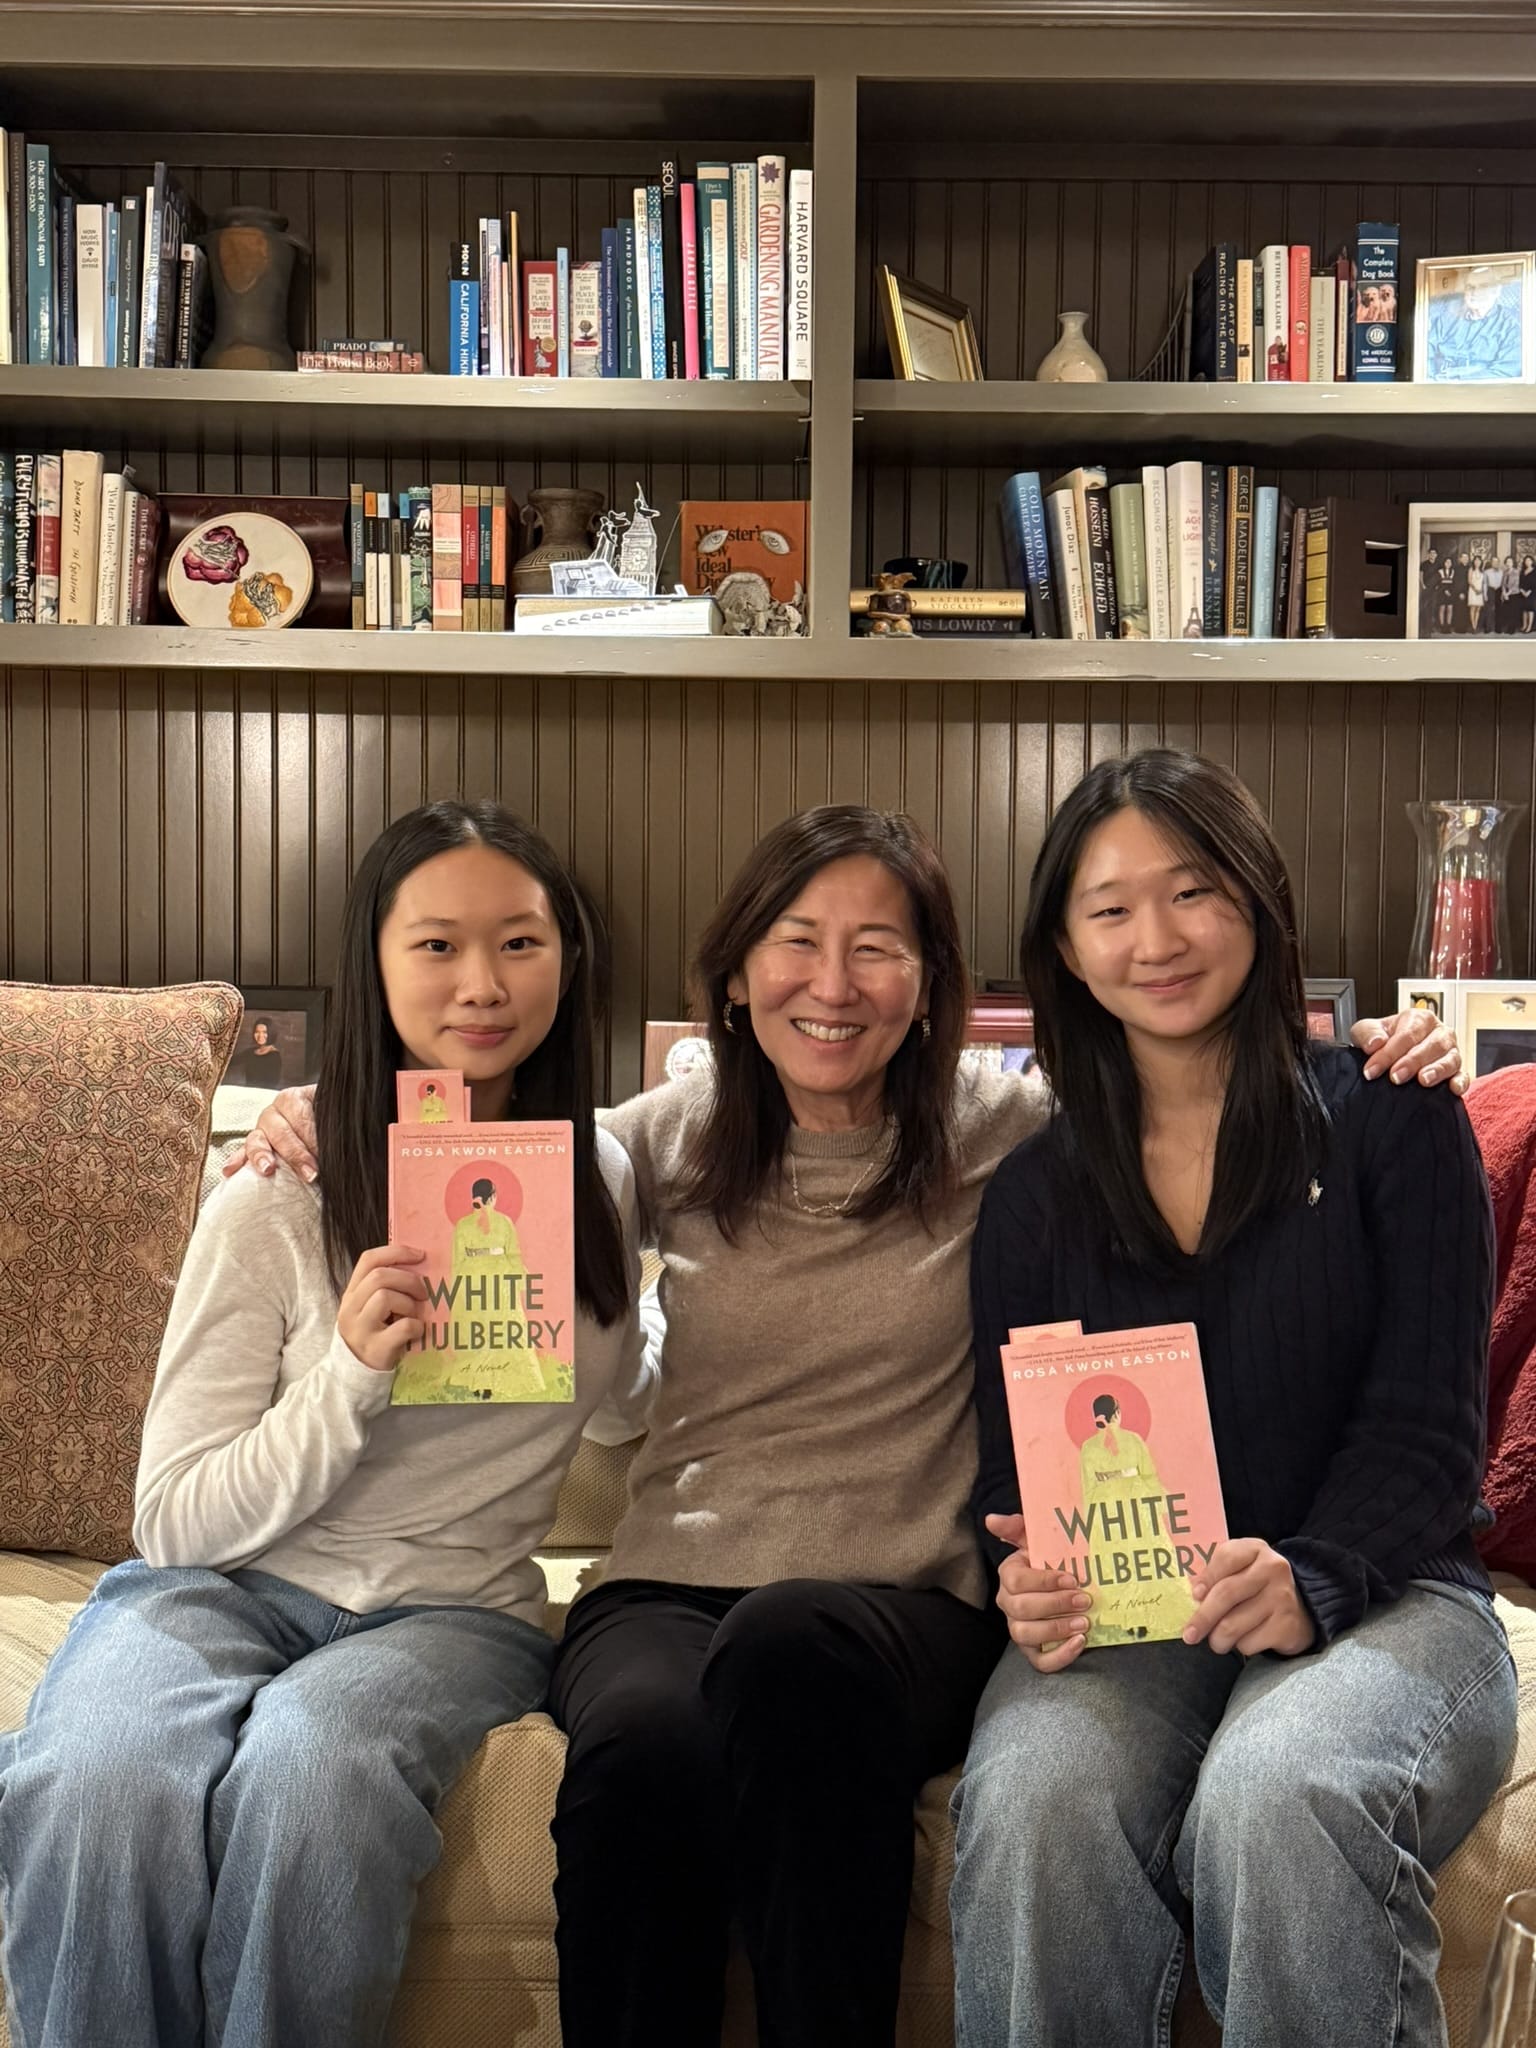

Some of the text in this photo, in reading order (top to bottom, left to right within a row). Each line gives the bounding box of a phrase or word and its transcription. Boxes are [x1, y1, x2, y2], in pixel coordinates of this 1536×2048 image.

[662, 161, 674, 198] SEOUL
[36, 160, 46, 267] the art of medieval spain
[714, 202, 726, 281] CHAPMAN
[740, 241, 748, 261] GOLF
[759, 204, 780, 290] GARDENING
[1275, 251, 1281, 261] BE
[1373, 246, 1385, 255] The
[461, 244, 470, 276] MOON
[687, 242, 696, 276] JAPAN
[796, 202, 808, 342] HARVARD SQUARE
[1219, 252, 1227, 296] RACING
[1363, 258, 1394, 268] Complete
[704, 274, 712, 292] Small
[1362, 270, 1394, 280] Dog Book
[182, 306, 190, 326] BRAIN
[704, 294, 712, 309] Boat
[1219, 300, 1227, 311] IN
[460, 283, 470, 376] CALIFORNIA HIKIN
[702, 310, 712, 340] Handling
[716, 285, 727, 362] PILOTING
[759, 295, 780, 368] MANUAL
[1219, 315, 1227, 337] THE
[1228, 328, 1235, 344] OF
[1316, 318, 1324, 337] THE
[332, 342, 367, 351] PRADO
[302, 355, 324, 368] The
[365, 356, 393, 370] Book
[73, 480, 84, 506] DONNA
[1239, 475, 1248, 511] CIRCE
[102, 488, 118, 556] Walter Mosley
[139, 508, 149, 550] THE SECRET
[1018, 487, 1036, 578] CHARLES FRAZIER
[1062, 506, 1072, 530] Junot
[1089, 496, 1103, 548] HOSSEINI
[1101, 508, 1109, 540] KHALED
[1208, 502, 1218, 555] Nightingale
[1028, 485, 1050, 600] COLD MOUNTAIN
[1283, 532, 1290, 540] M
[695, 558, 732, 574] Ideal
[1152, 479, 1165, 636] BECOMING MICHELLE OBAMA
[1236, 520, 1247, 626] MADELINE MILLER
[108, 570, 116, 581] The
[1092, 562, 1108, 613] ECHOED
[1279, 579, 1287, 598] Smith
[930, 596, 983, 604] KATHRYN
[1106, 576, 1116, 626] MOUNTAINS
[1204, 576, 1212, 630] HANNAH
[1213, 577, 1221, 628] KRISTIN
[938, 618, 996, 631] LOWRY
[401, 1144, 566, 1158] ROSA KWON EASTON
[423, 1273, 544, 1312] WHITE
[460, 1361, 510, 1373] A Novel
[1012, 1366, 1058, 1380] ROSA
[1064, 1358, 1114, 1374] KWON
[1122, 1349, 1190, 1367] EASTON
[1054, 1492, 1190, 1544] WHITE
[1108, 1593, 1163, 1610] A Novel
